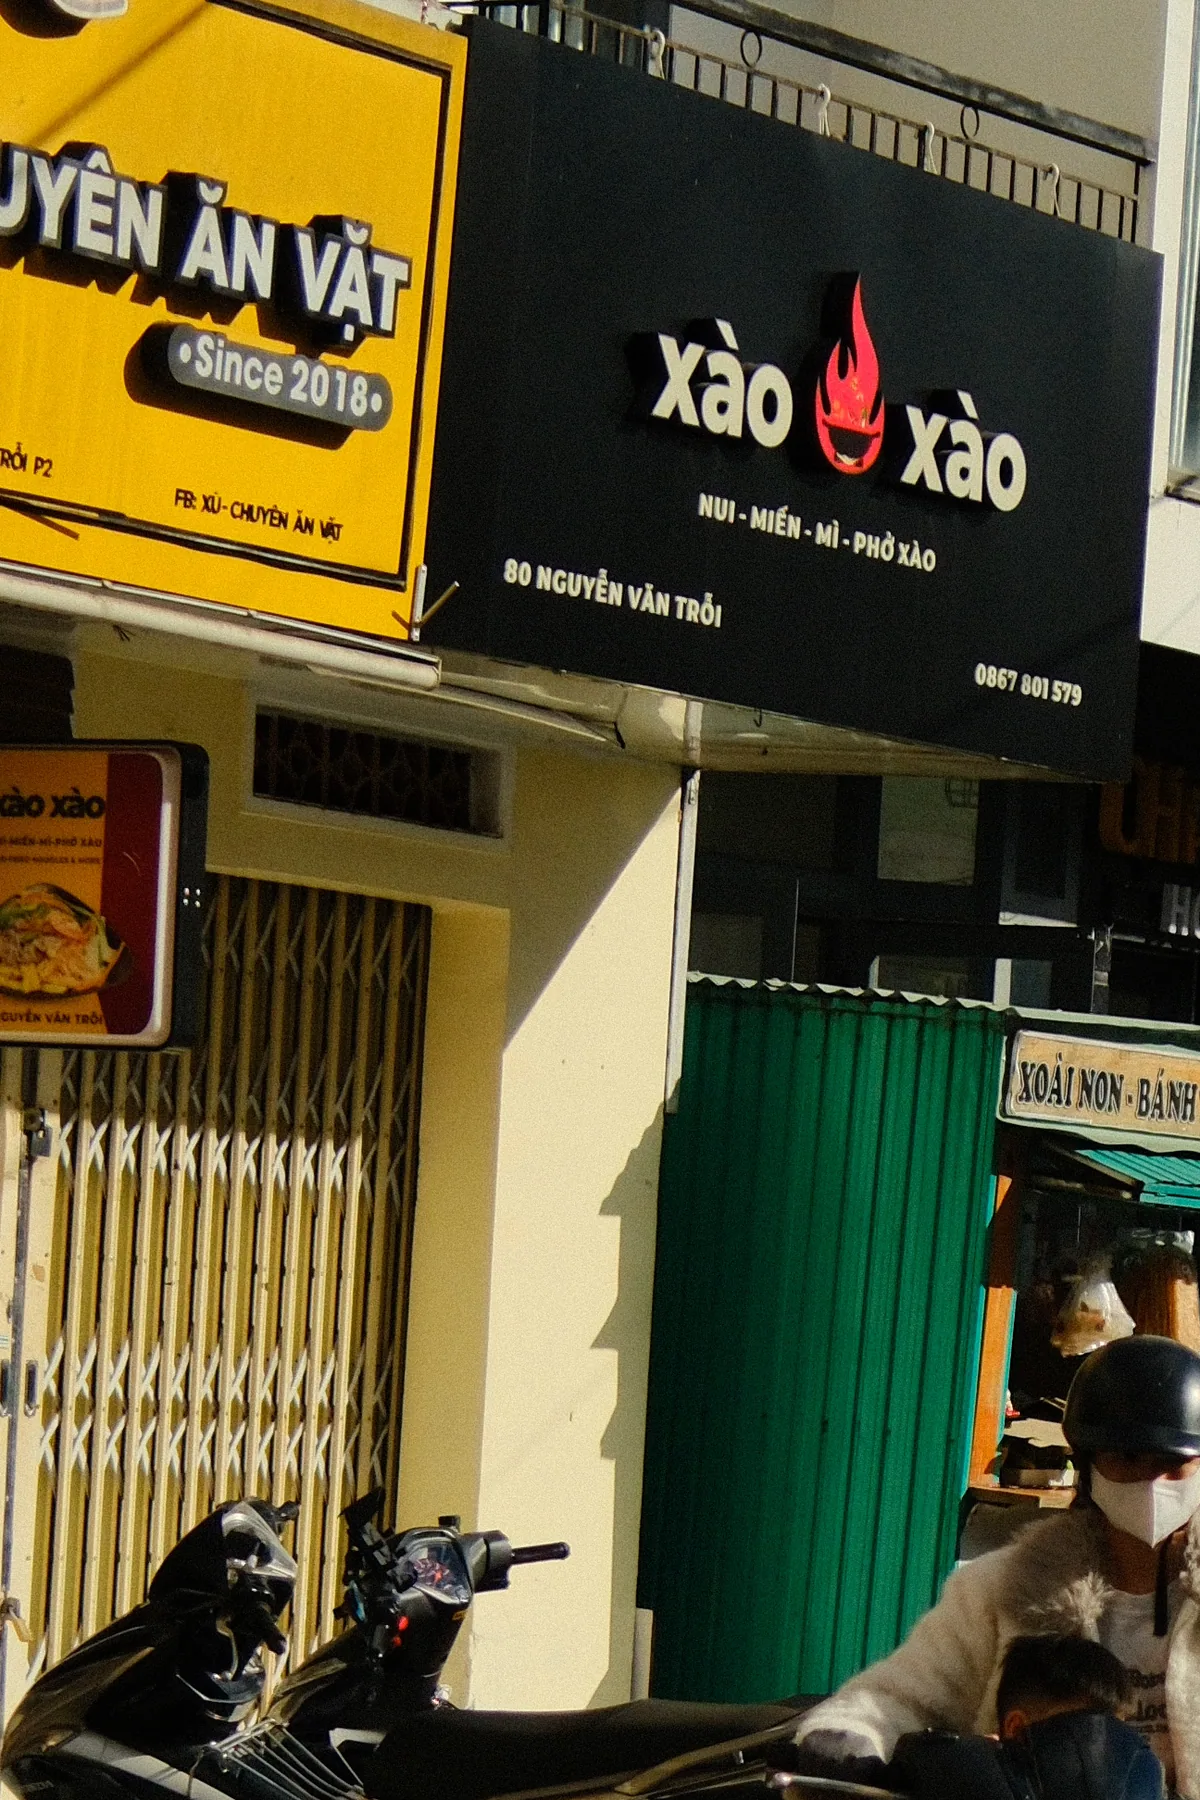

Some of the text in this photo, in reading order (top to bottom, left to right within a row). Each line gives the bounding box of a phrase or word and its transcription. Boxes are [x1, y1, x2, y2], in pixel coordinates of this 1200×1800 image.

[180, 181, 276, 300] ĂN
[295, 222, 410, 341] VẶT
[194, 334, 369, 418] Since 2018
[651, 318, 793, 447] xào
[33, 456, 53, 478] P2
[901, 390, 1026, 511] xào
[293, 510, 314, 536] ĂN
[320, 517, 344, 544] VẶT
[698, 493, 736, 524] NUI
[749, 505, 802, 539] MIẾN
[814, 520, 839, 549] MÌ
[853, 531, 894, 562] PHỞ
[897, 541, 938, 573] XÀO
[503, 558, 723, 628] 80 NGUYỄN VĂN TRỖI
[974, 662, 1083, 707] 0867 801 579
[0, 786, 105, 819] ào xào
[1018, 1053, 1074, 1107] XOÀI
[1078, 1069, 1124, 1113] NON
[1137, 1069, 1198, 1122] BÁNH
